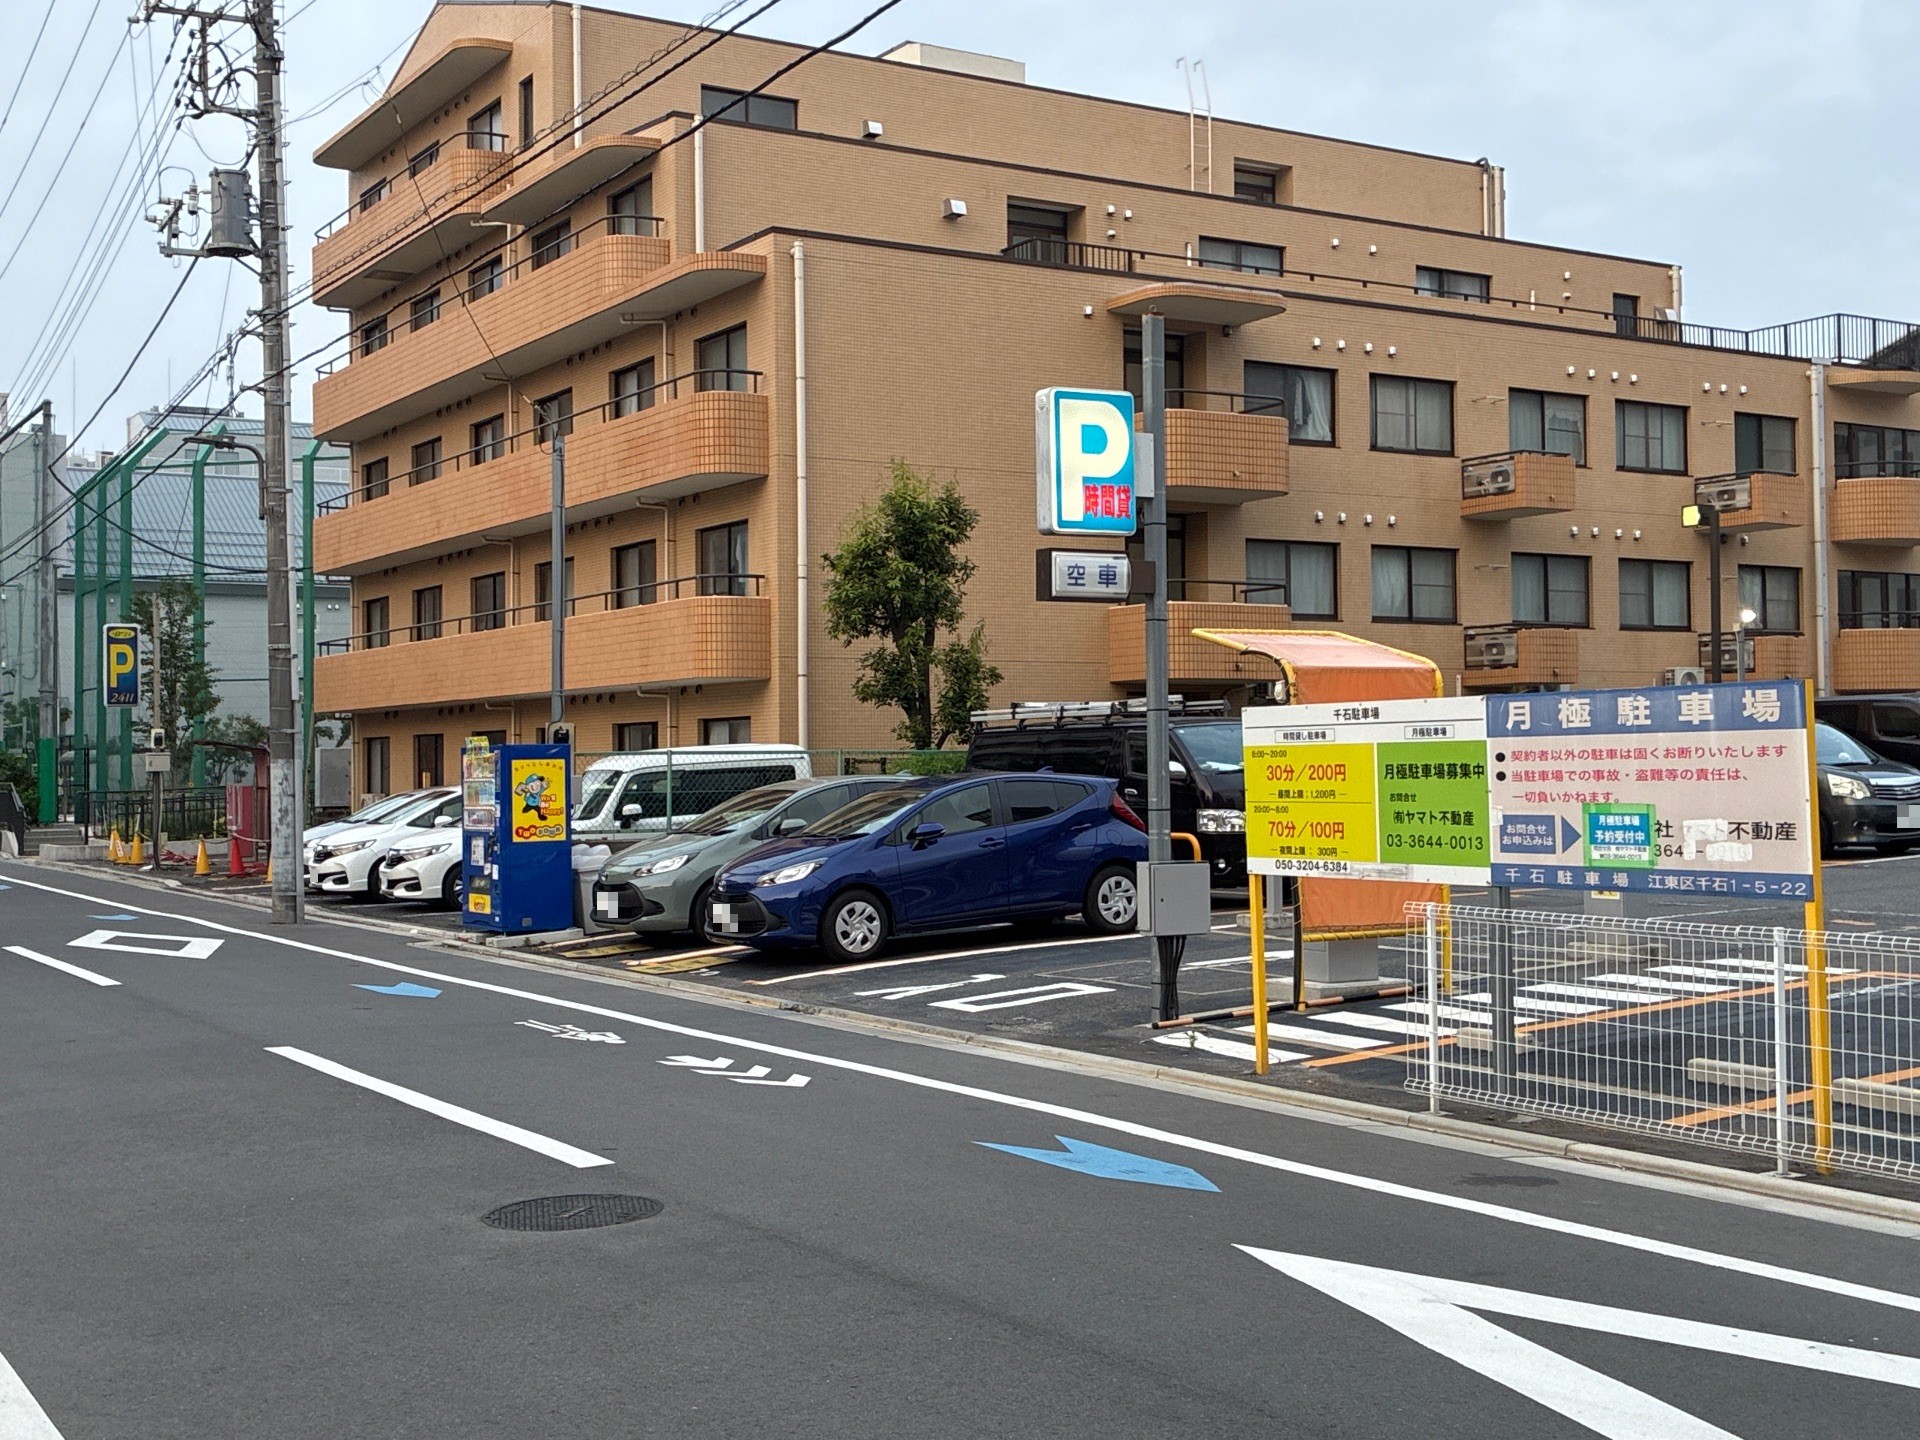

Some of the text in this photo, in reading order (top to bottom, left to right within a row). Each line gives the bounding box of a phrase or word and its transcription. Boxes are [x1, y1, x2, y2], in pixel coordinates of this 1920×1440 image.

[1059, 398, 1130, 522] P
[1084, 484, 1131, 519] 時間貸
[1067, 563, 1118, 588] 空車
[110, 644, 134, 687] P
[1333, 707, 1380, 721] 千石駐車場
[1505, 689, 1781, 731] 月極駐車場
[1411, 727, 1447, 737] 月極駐車場
[1511, 744, 1788, 763] 契約者以外の駐車は固くお断りいたします
[1384, 762, 1485, 780] 月極駐車場募集中
[1511, 767, 1749, 783] 当駐車場での事故・盗難等の責任は、
[1389, 792, 1417, 802] お問合せ
[1512, 790, 1620, 804] 一切負いかねます。
[1506, 823, 1547, 835] お問合せ
[1598, 815, 1640, 827] 月極駐車場
[1386, 833, 1484, 851] 03-3644-0013
[1502, 835, 1554, 847] お申込みは
[1594, 829, 1645, 844] 予約受付中
[1275, 859, 1348, 872] 050-3204-6384
[1505, 868, 1629, 888] 千石駐車場
